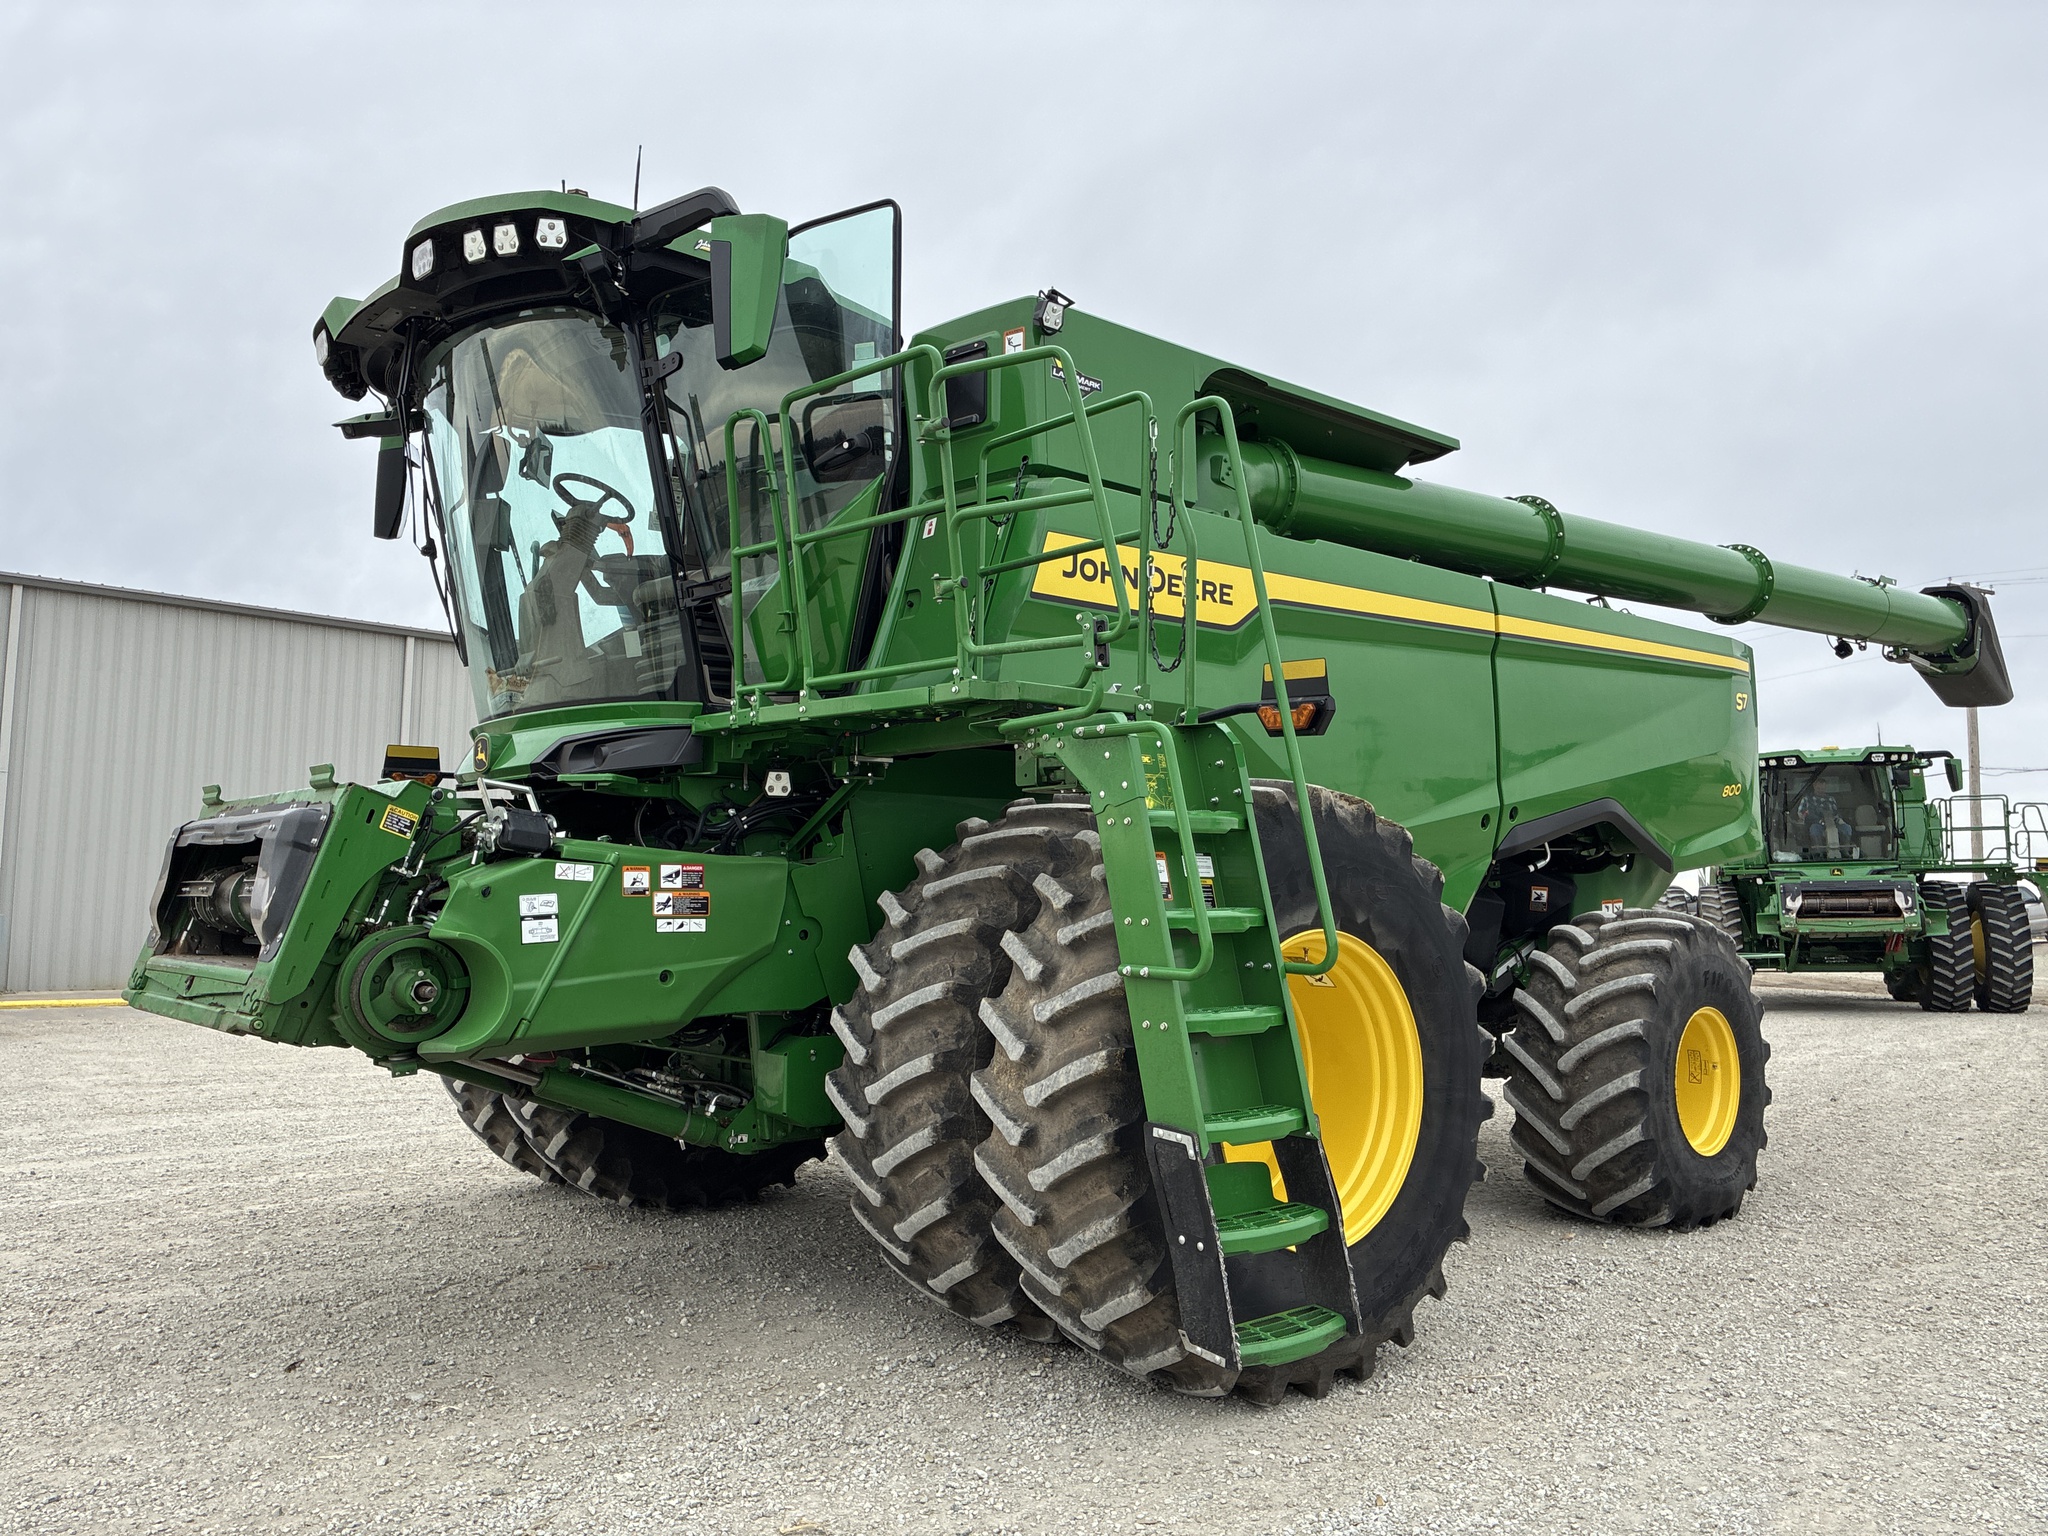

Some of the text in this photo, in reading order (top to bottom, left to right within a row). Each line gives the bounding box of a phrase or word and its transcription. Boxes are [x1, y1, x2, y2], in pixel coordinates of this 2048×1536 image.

[1052, 367, 1101, 390] LAMARK
[1062, 553, 1234, 606] JOHN DERE
[1736, 692, 1748, 711] S7
[1722, 783, 1742, 798] 800
[393, 808, 418, 821] CAUTION
